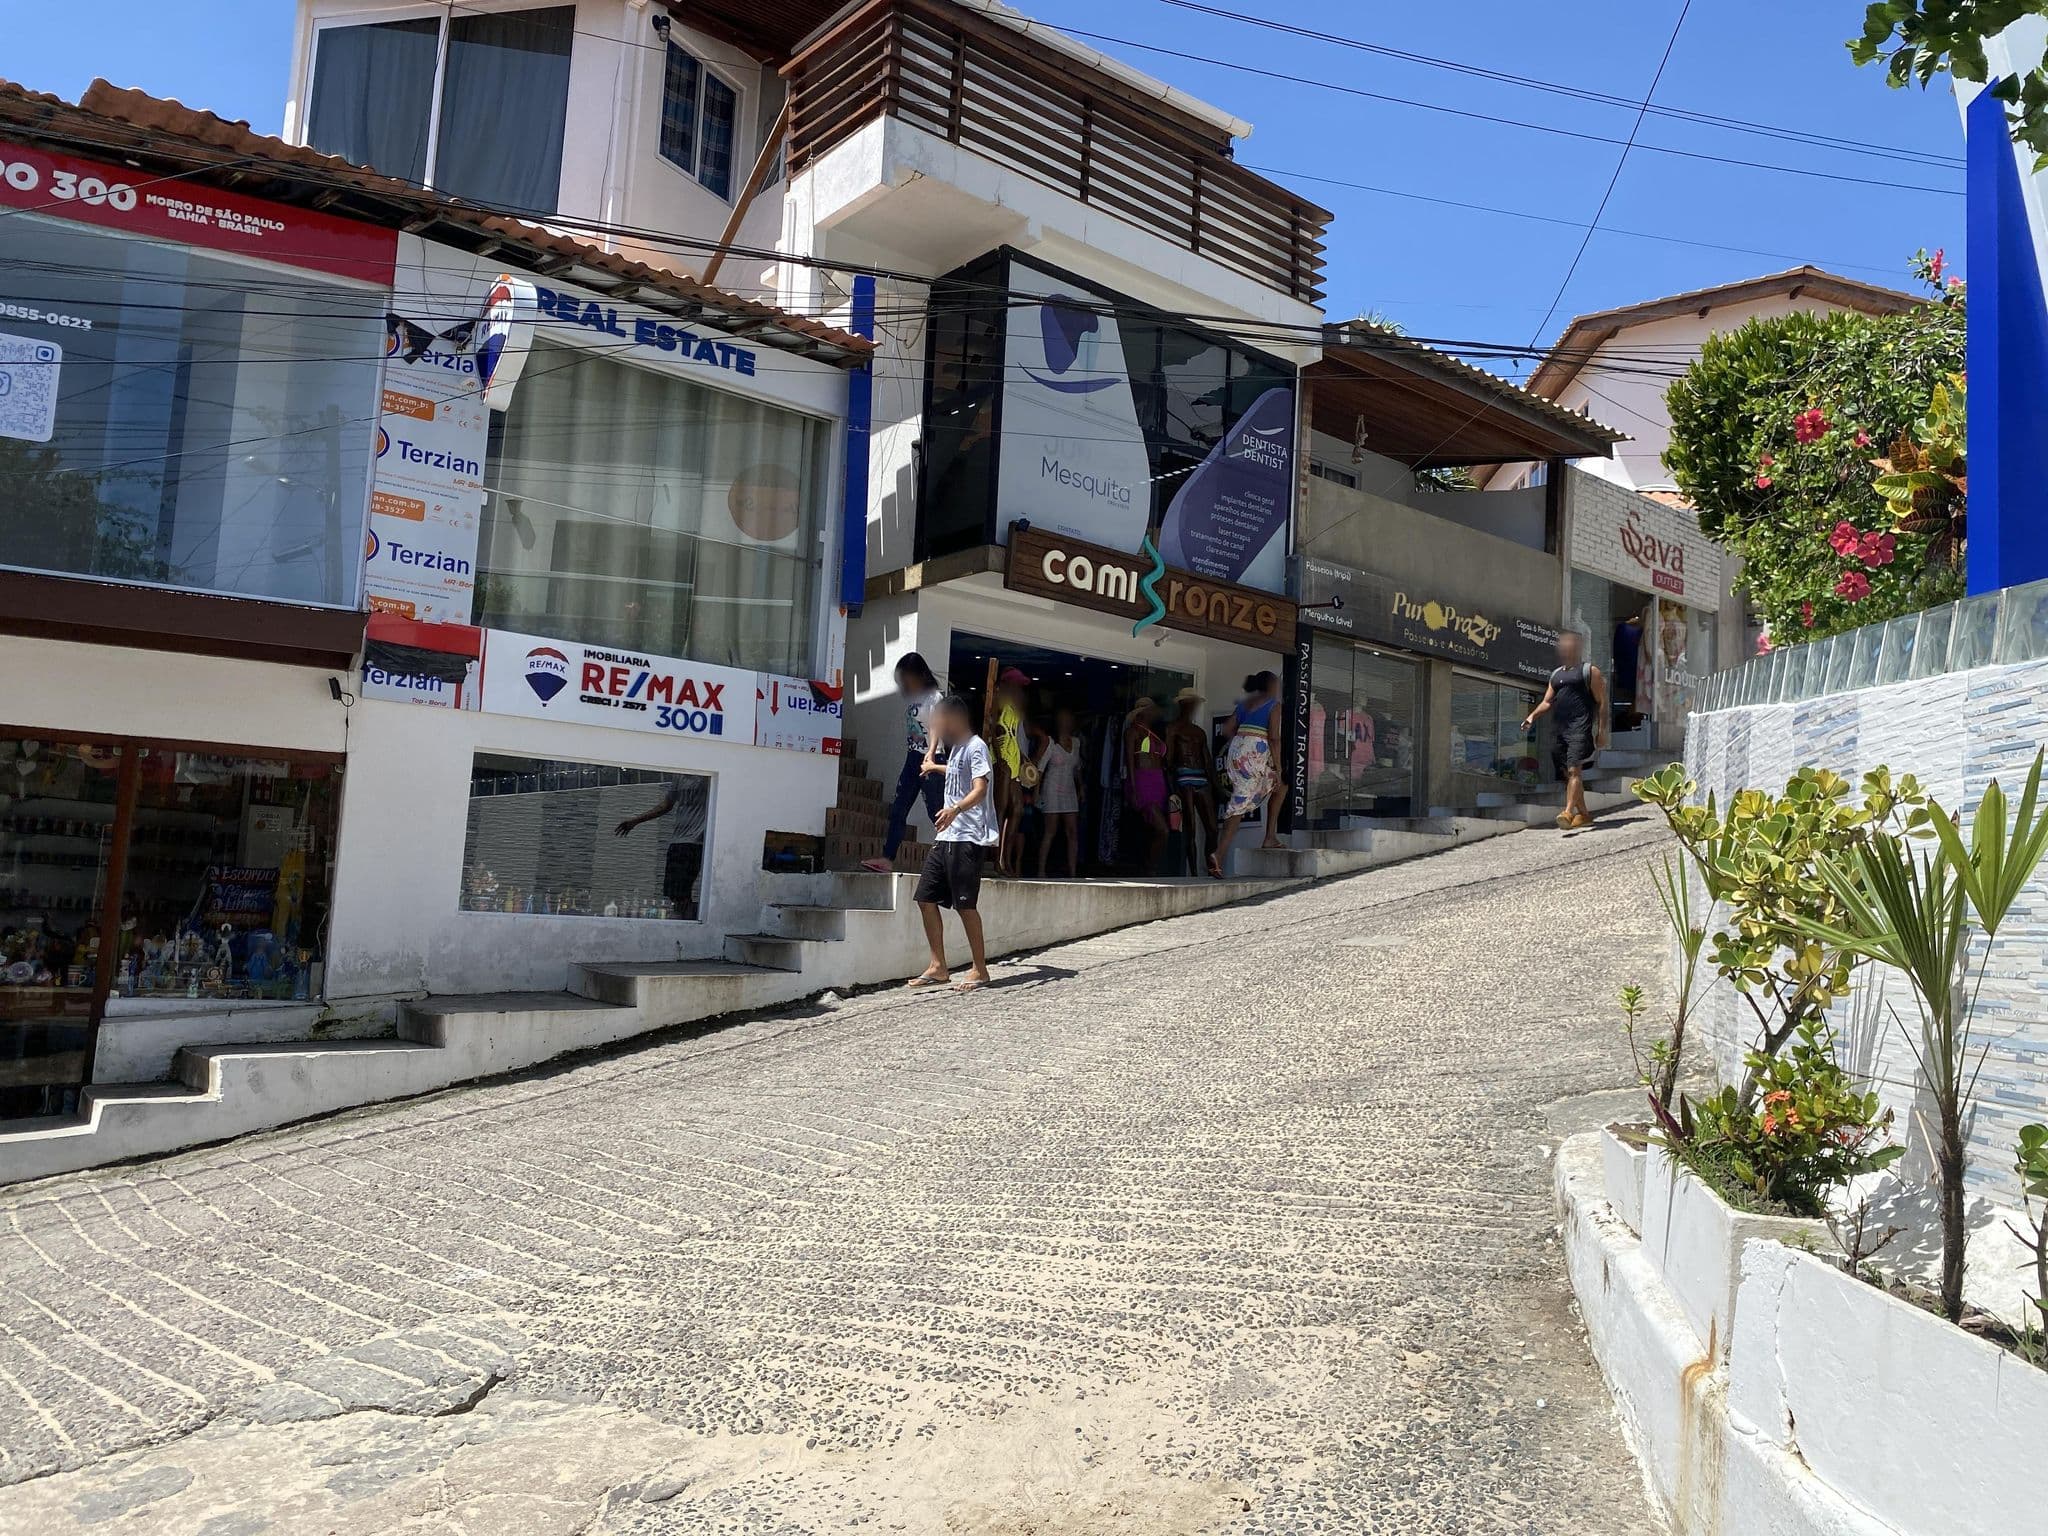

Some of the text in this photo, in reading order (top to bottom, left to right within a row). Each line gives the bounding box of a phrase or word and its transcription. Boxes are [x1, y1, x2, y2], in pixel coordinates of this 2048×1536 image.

[49, 170, 137, 211] 300
[146, 194, 286, 232] MORRO DE SÃO PAULO
[168, 208, 208, 225] BAHIA
[218, 218, 262, 235] BRASIL
[536, 286, 627, 338] REAL
[634, 317, 756, 377] ESTATE
[397, 440, 479, 476] Terzian
[1242, 433, 1288, 459] DENTISTA
[1244, 448, 1284, 470] DENTIST
[1041, 456, 1130, 504] Mesquita
[387, 542, 470, 575] Terzian
[1042, 550, 1138, 603] cami
[1656, 574, 1683, 591] OUTLET
[529, 660, 566, 673] RE/MAX
[584, 649, 651, 668] IMOBILIARIA
[581, 662, 725, 711] RE/MAX
[1300, 642, 1310, 715] PASSEIOS
[655, 705, 708, 732] 300
[1295, 733, 1306, 817] TRANSFER
